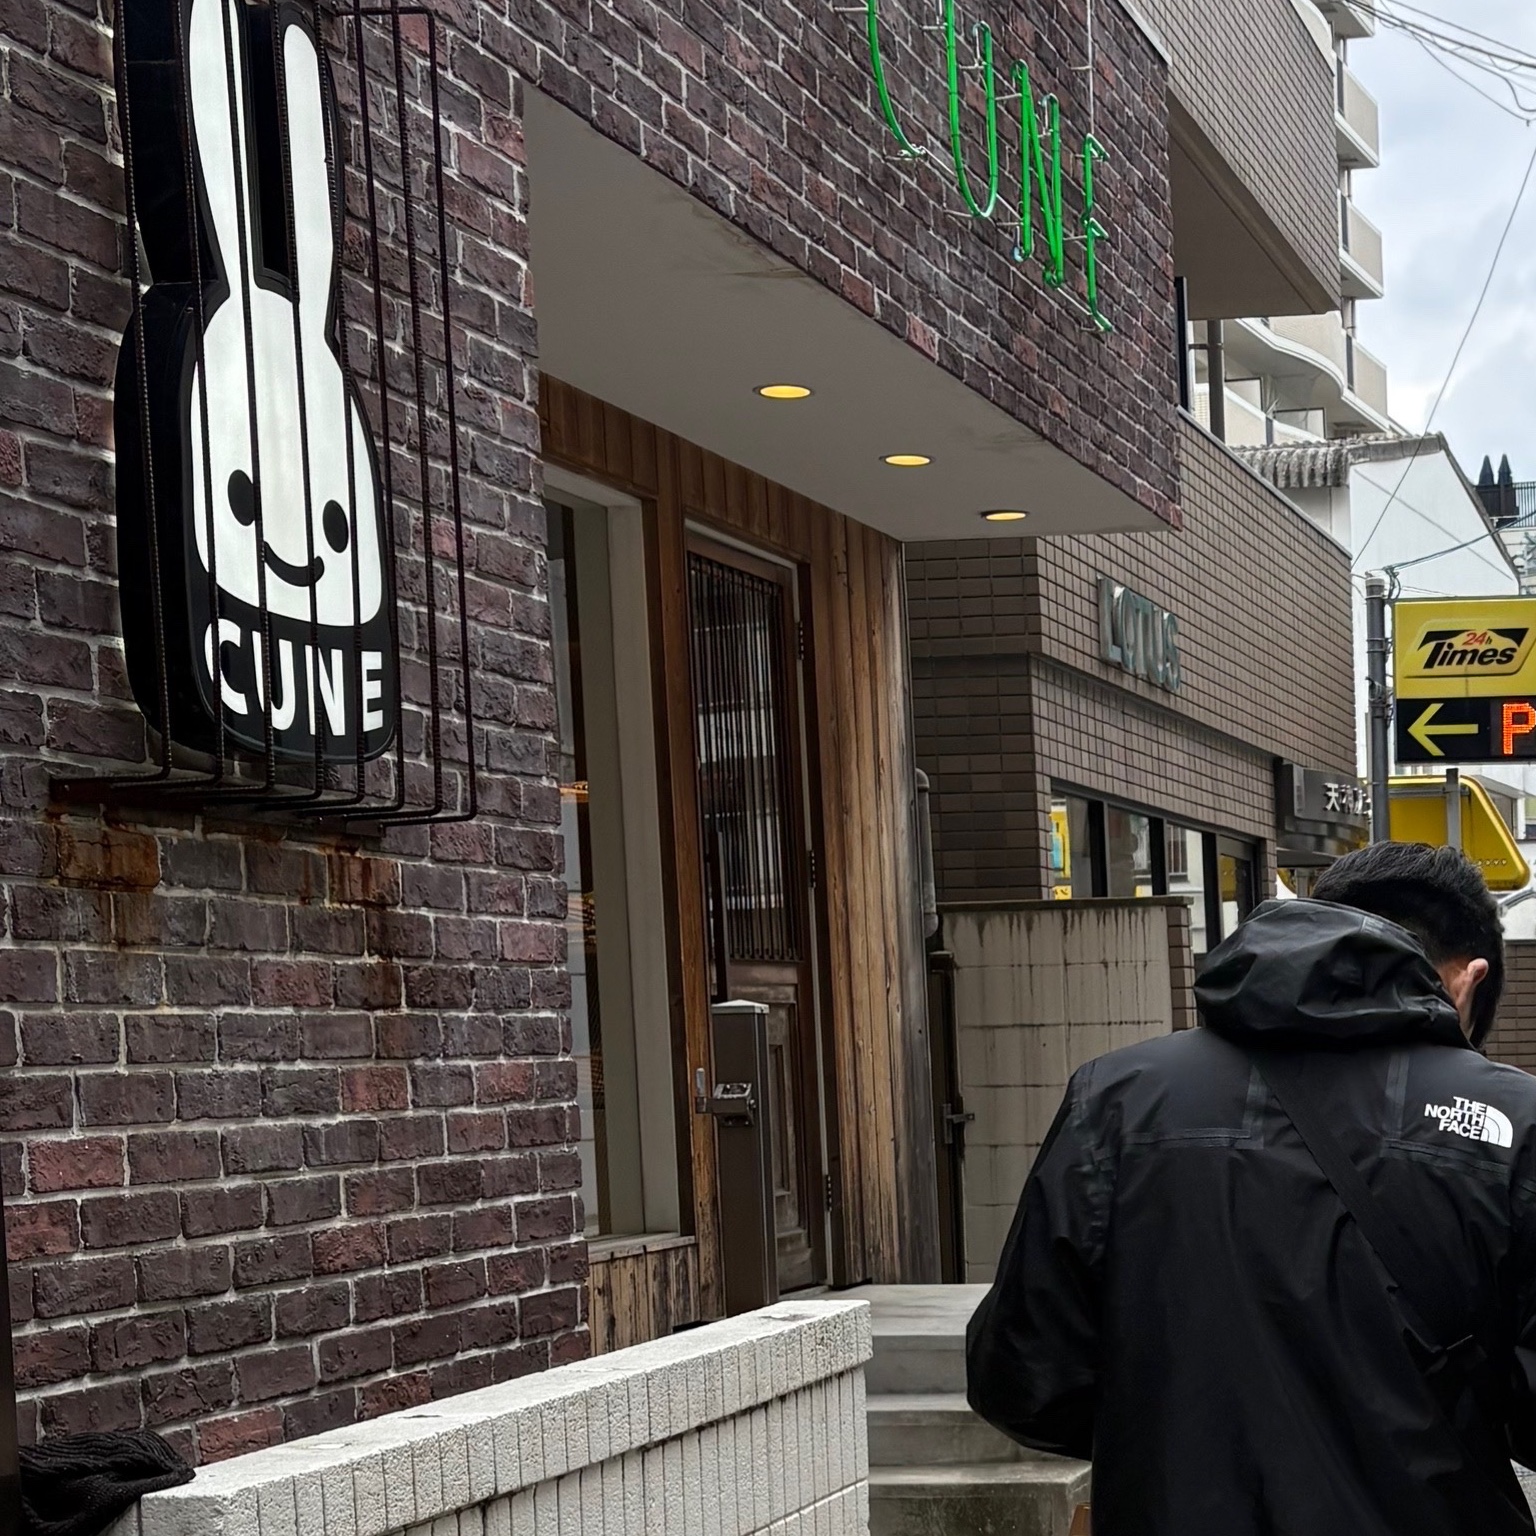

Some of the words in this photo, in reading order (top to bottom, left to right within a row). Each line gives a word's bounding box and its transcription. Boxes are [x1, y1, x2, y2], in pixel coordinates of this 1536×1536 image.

[1422, 640, 1518, 670] Times
[204, 618, 384, 737] CUNE
[1424, 1103, 1486, 1128] NORTH
[1453, 1096, 1487, 1115] THE
[1438, 1118, 1482, 1141] FACE
